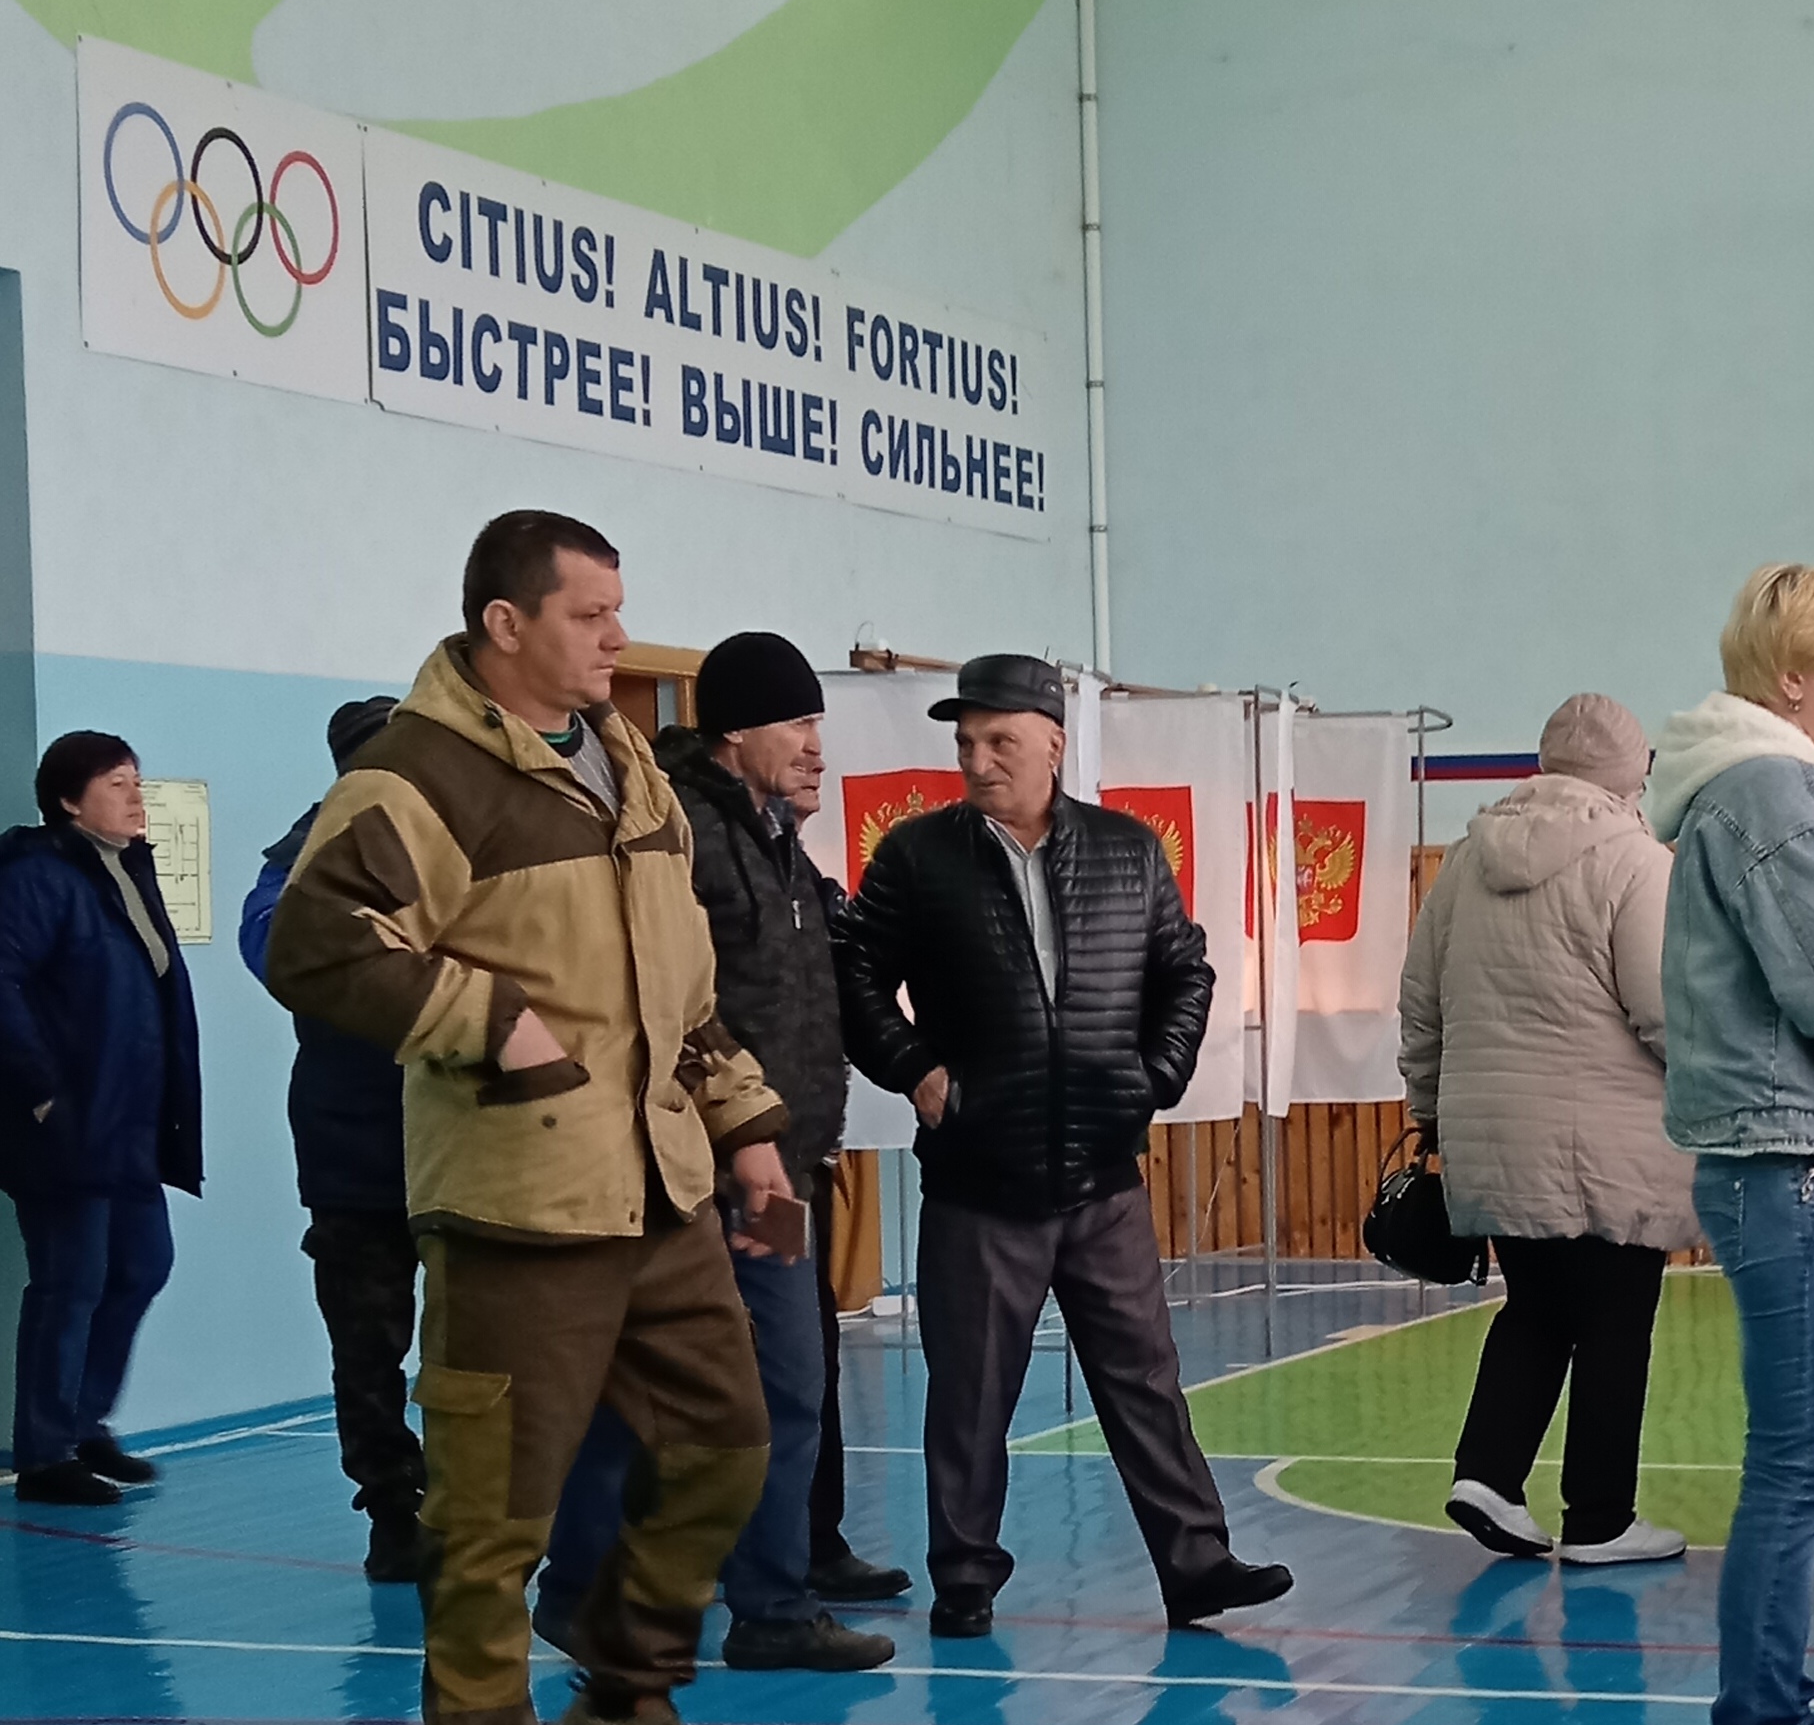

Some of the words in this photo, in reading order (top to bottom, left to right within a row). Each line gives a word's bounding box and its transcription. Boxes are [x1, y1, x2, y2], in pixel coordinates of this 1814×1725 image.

[376, 287, 652, 427] БЫСТРЕЕ!
[681, 364, 838, 465] ВЫШЕ!
[861, 409, 1045, 512] СИЛЬНЕЕ!
[418, 181, 614, 309] CITIUS!
[644, 248, 822, 362] ALTIUS!
[846, 305, 1018, 415] FORTIUS!
